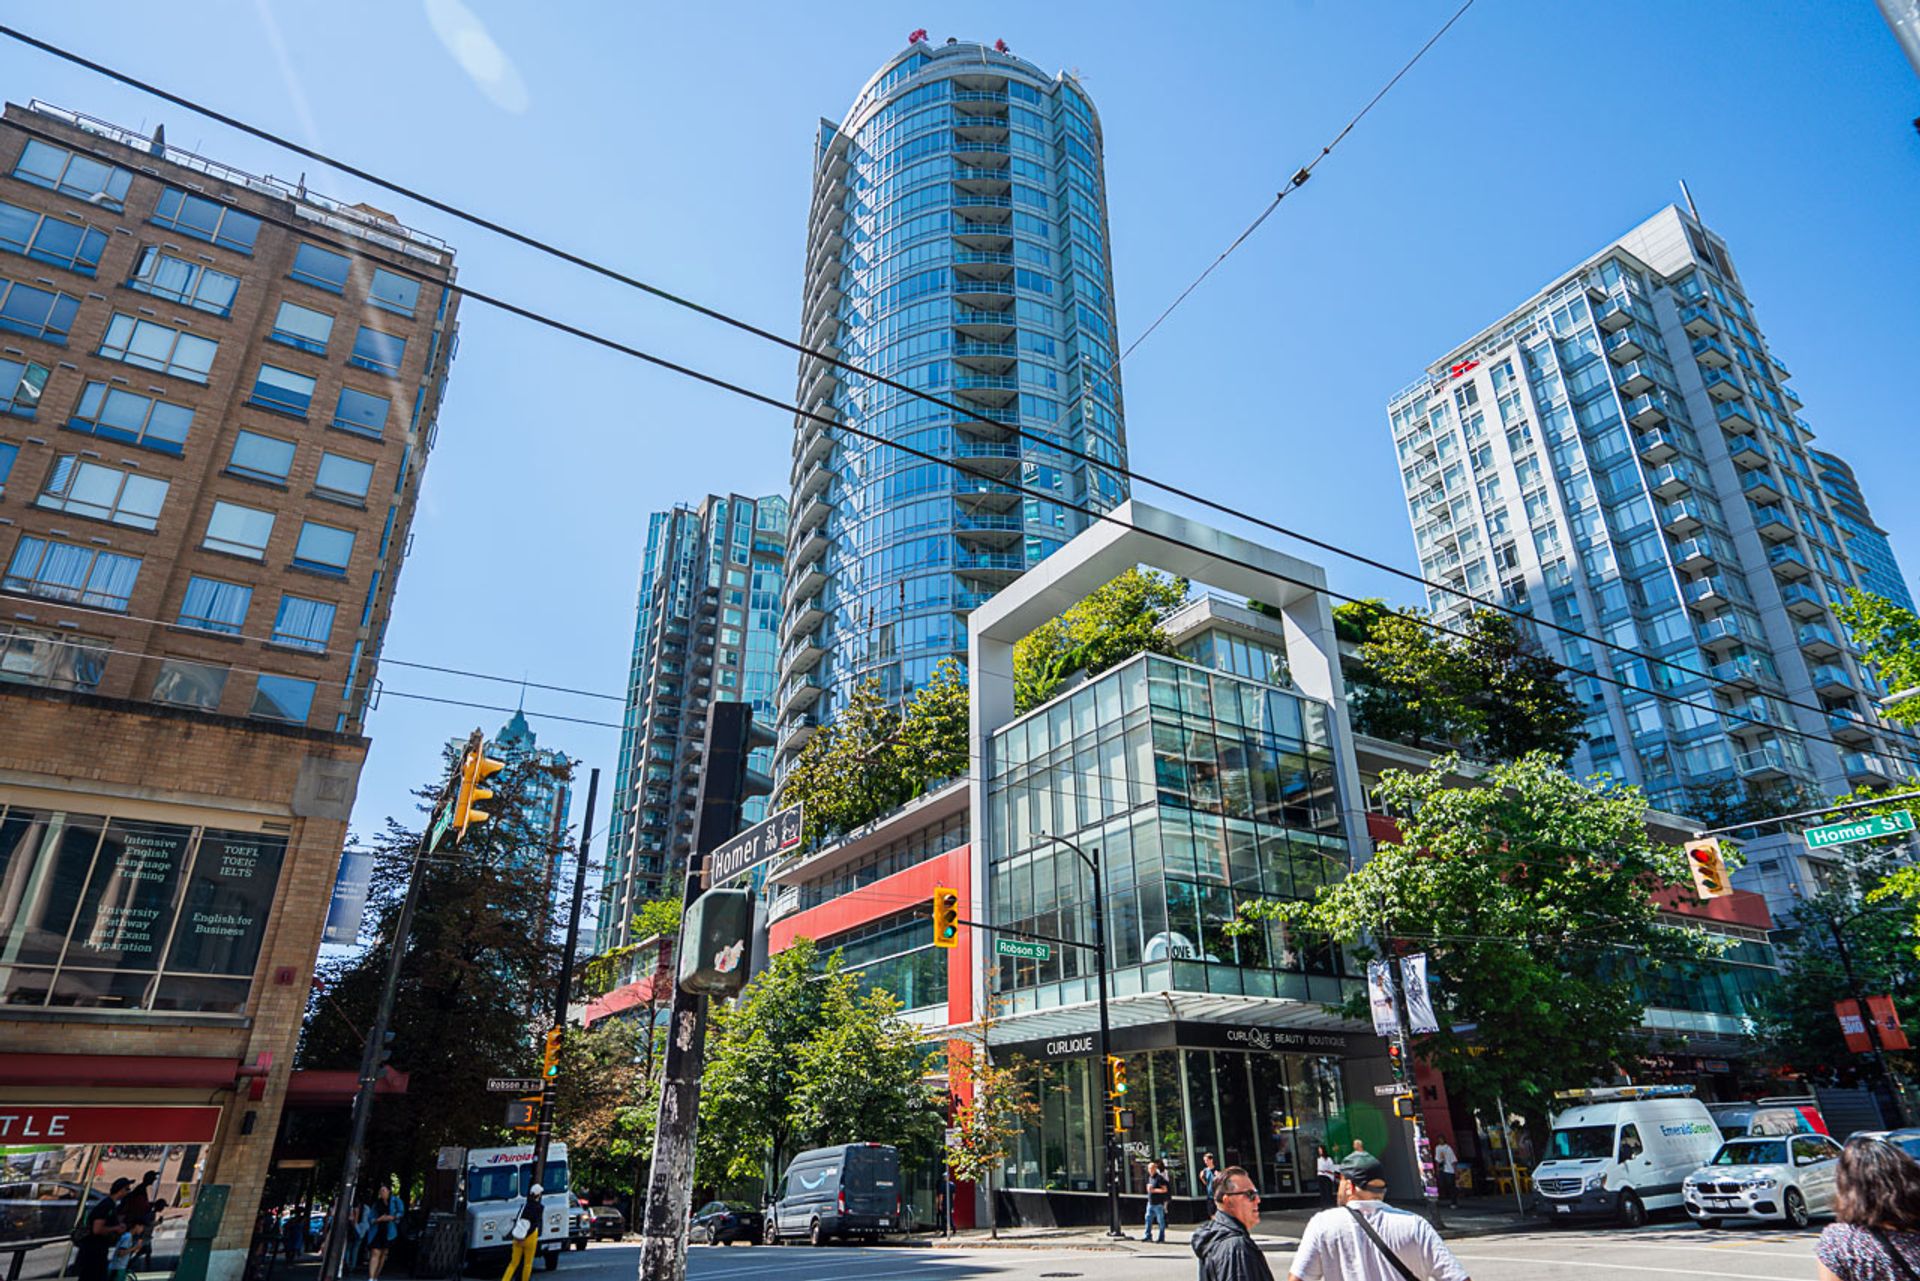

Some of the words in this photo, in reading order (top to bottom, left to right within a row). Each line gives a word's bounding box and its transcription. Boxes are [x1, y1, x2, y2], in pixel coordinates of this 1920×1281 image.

[1813, 823, 1873, 845] Homer
[1880, 816, 1904, 831] St
[123, 835, 177, 849] Intensive
[125, 846, 169, 859] English
[224, 846, 260, 857] TOEFL
[715, 835, 760, 880] Homer
[115, 857, 172, 872] Language
[222, 857, 256, 867] TOEIC
[117, 868, 165, 882] Training
[219, 867, 253, 878] IELTS
[97, 904, 160, 920] University
[193, 912, 235, 926] English
[237, 916, 253, 926] for
[101, 917, 150, 930] Pathway
[195, 924, 245, 936] Business
[117, 930, 151, 941] Exam
[1000, 942, 1033, 956] Robson
[1036, 946, 1046, 957] St
[1047, 1036, 1093, 1055] CURLIQUE
[1274, 1033, 1304, 1044] BEAUTY
[1308, 1035, 1346, 1047] BOUTIQUE
[490, 1081, 520, 1089] Robson
[523, 1105, 533, 1122] 3
